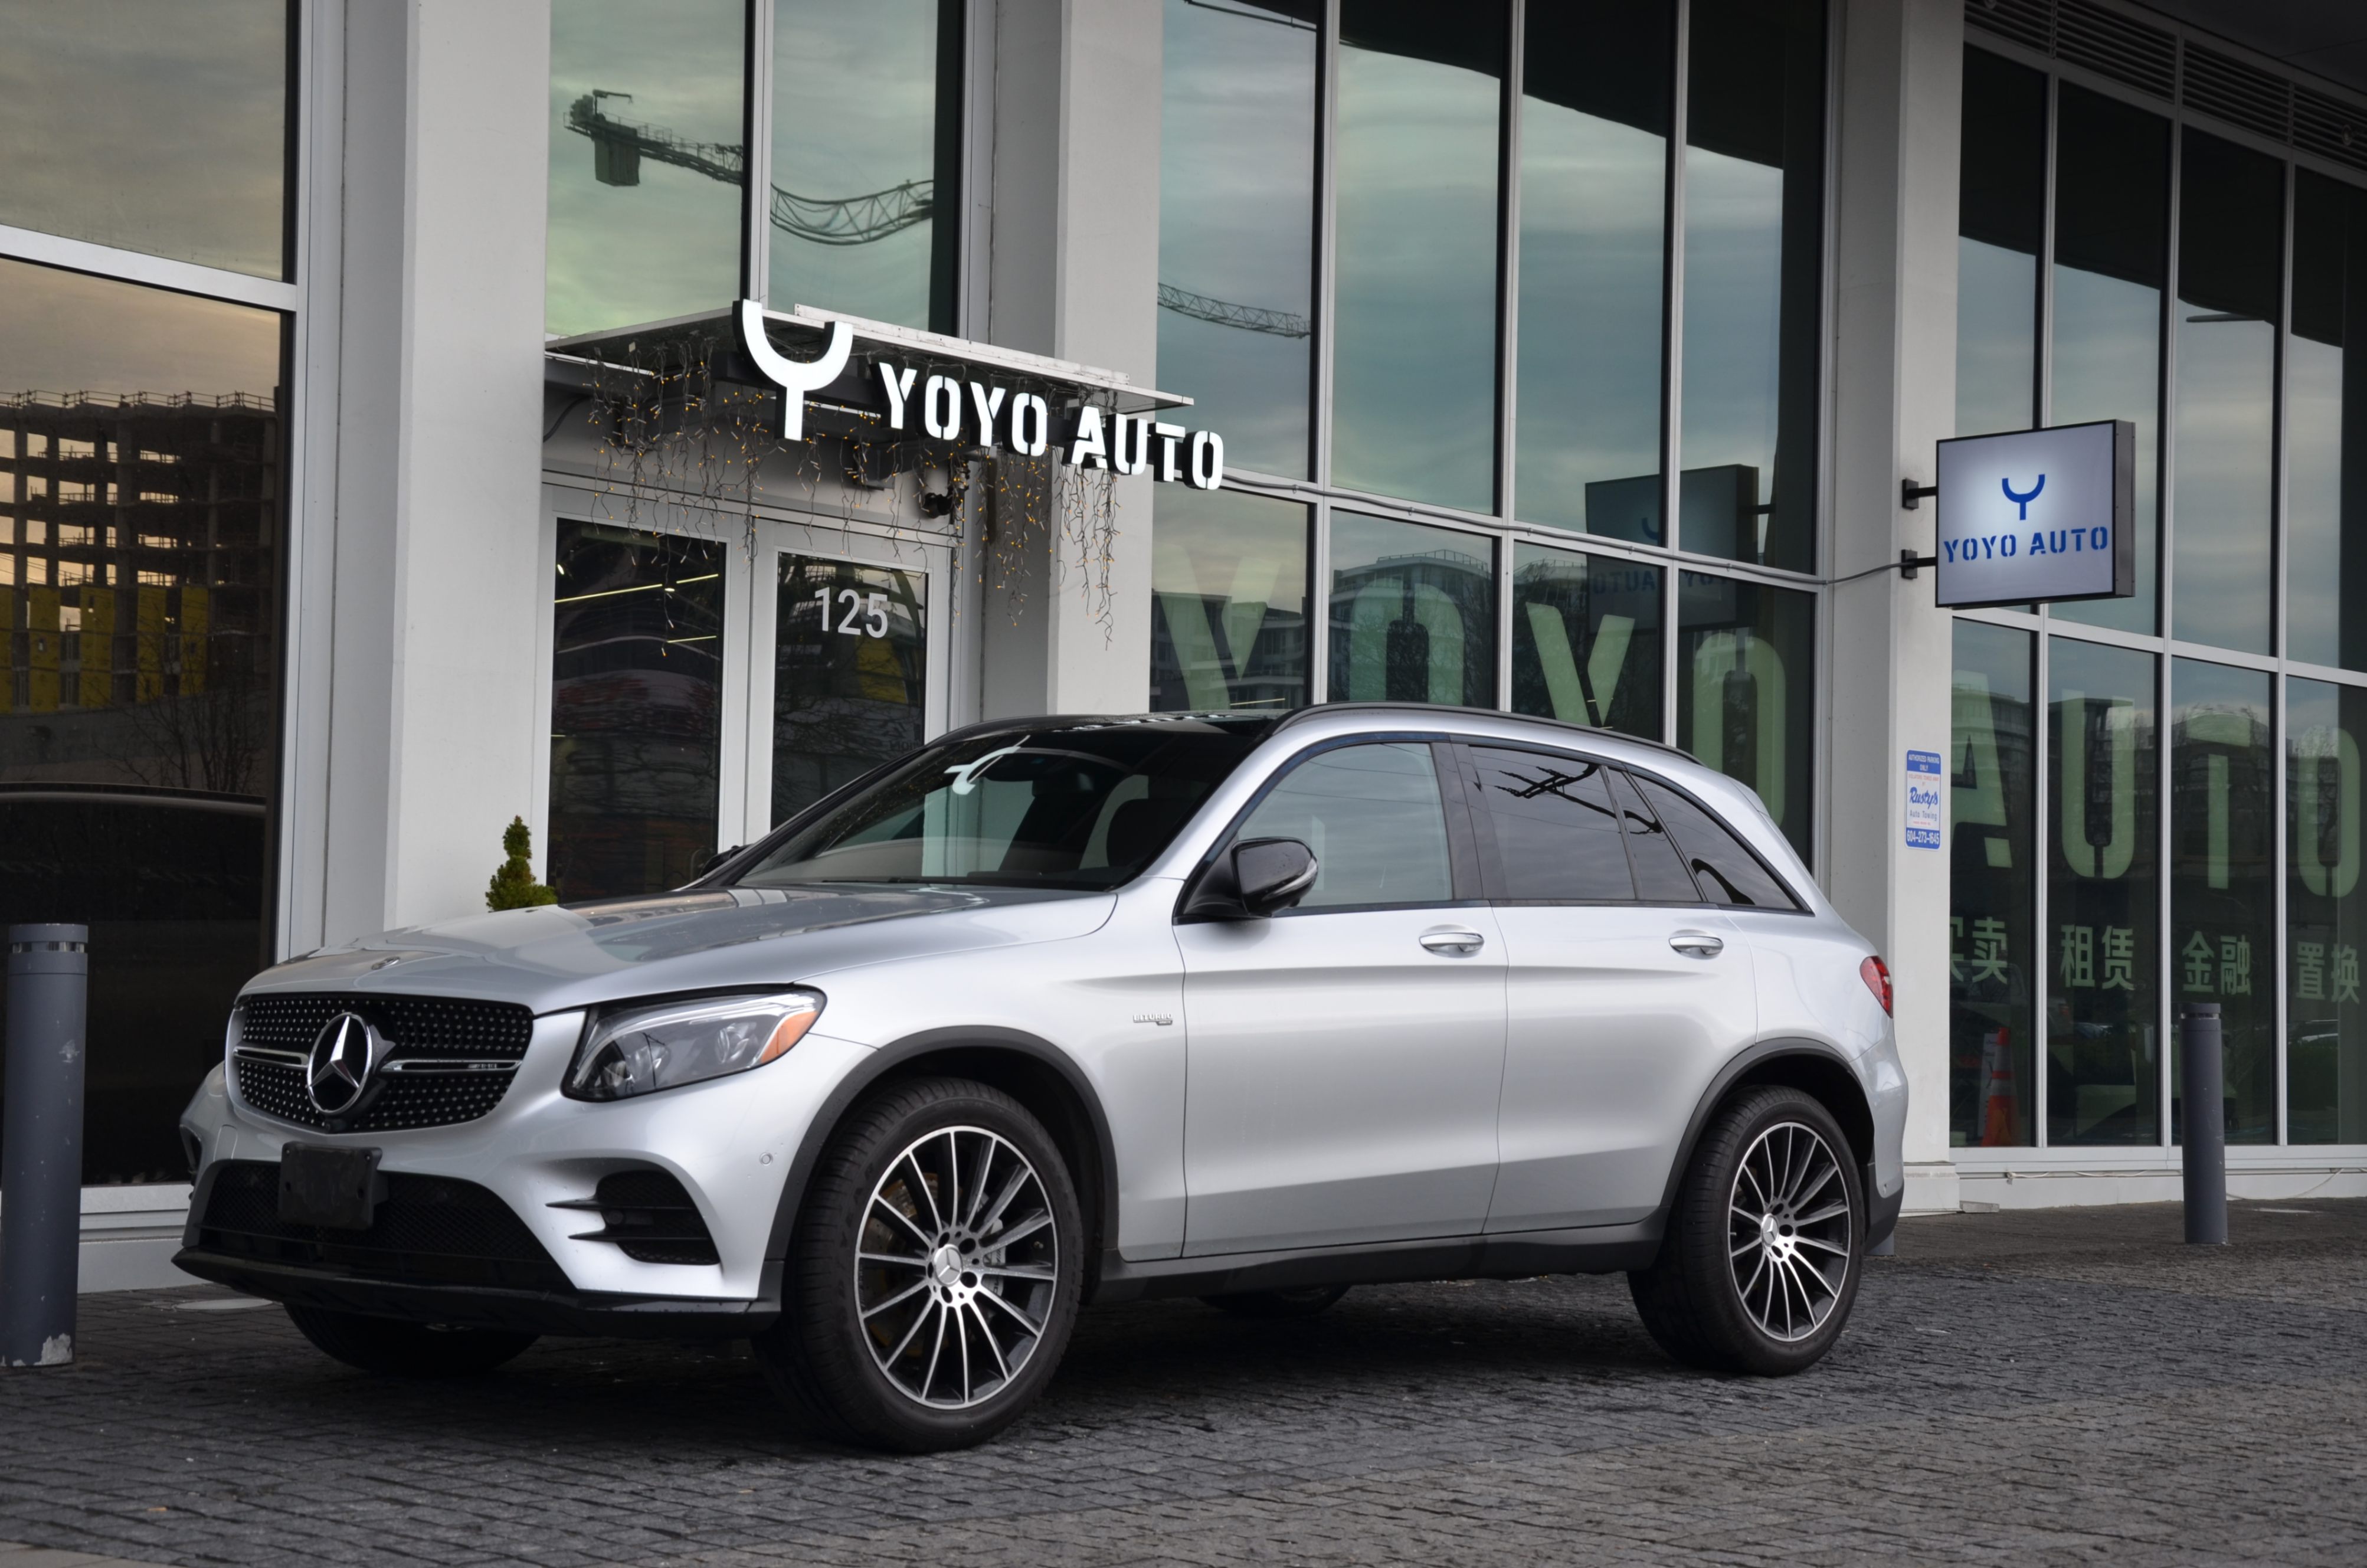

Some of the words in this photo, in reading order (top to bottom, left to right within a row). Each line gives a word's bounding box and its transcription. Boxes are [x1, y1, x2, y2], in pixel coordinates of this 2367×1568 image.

[878, 362, 1048, 457] YOYO
[1070, 405, 1225, 490] AUTO
[1944, 534, 2016, 563] YOYO
[2029, 526, 2108, 556] AUTO
[814, 587, 888, 638] 125
[1927, 756, 1940, 764] PARKING
[1910, 787, 1938, 809] Rusty's
[1951, 670, 2360, 898] AUTO
[1910, 810, 1920, 818] Auto
[1922, 811, 1937, 821] Towing
[2061, 925, 2134, 990] 租赁
[2182, 931, 2252, 996] 金融
[2296, 941, 2361, 1004] 置换
